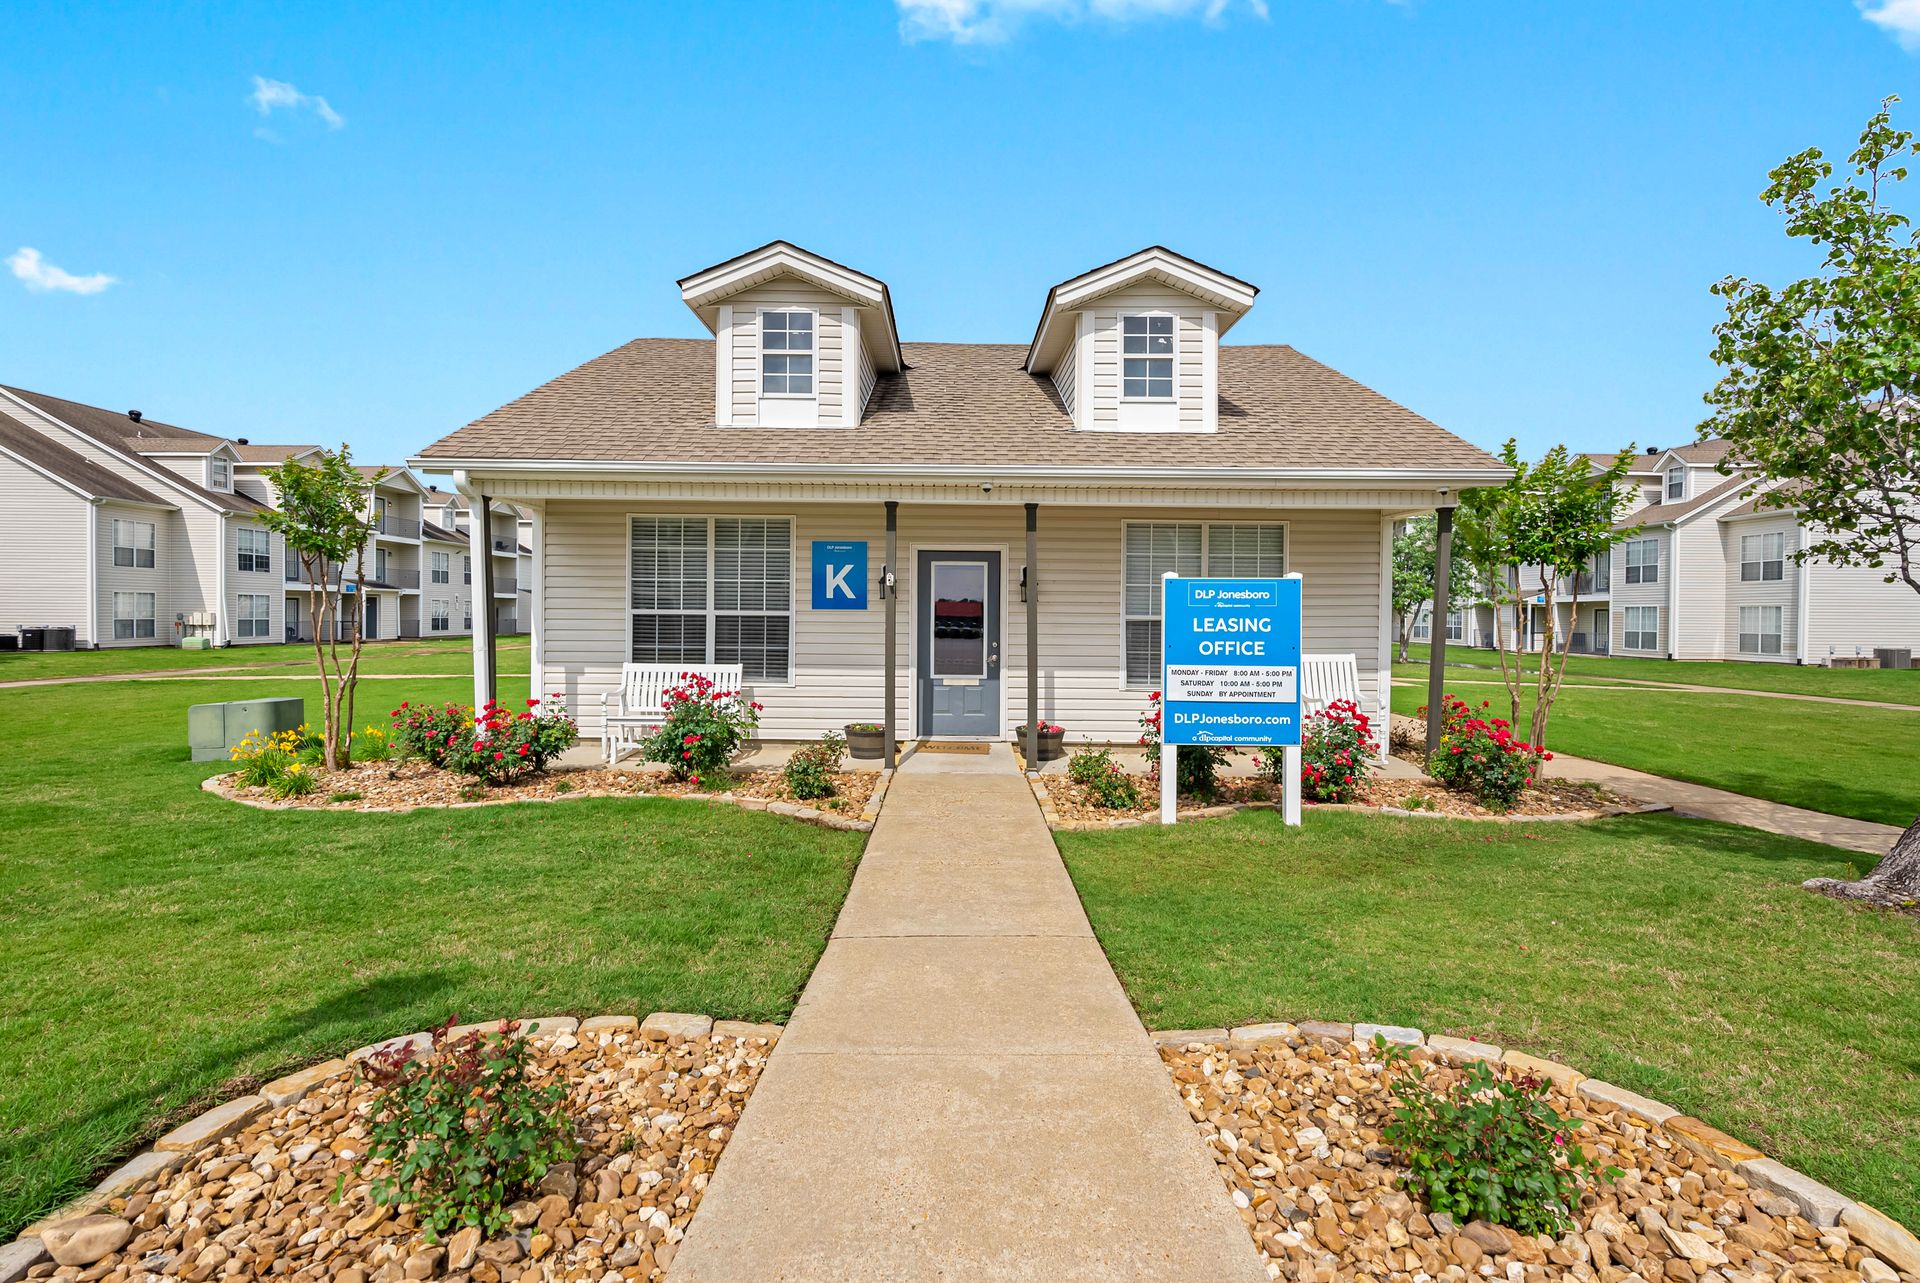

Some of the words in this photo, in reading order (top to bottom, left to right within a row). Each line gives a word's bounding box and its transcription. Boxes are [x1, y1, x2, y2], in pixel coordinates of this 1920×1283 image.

[826, 564, 857, 599] K
[1195, 589, 1215, 599] DLP
[1217, 589, 1270, 599] Jonesboro
[1193, 617, 1272, 633] LEASING
[1199, 641, 1265, 656] OFFICE
[1174, 713, 1291, 725] DLPJonesboro.com
